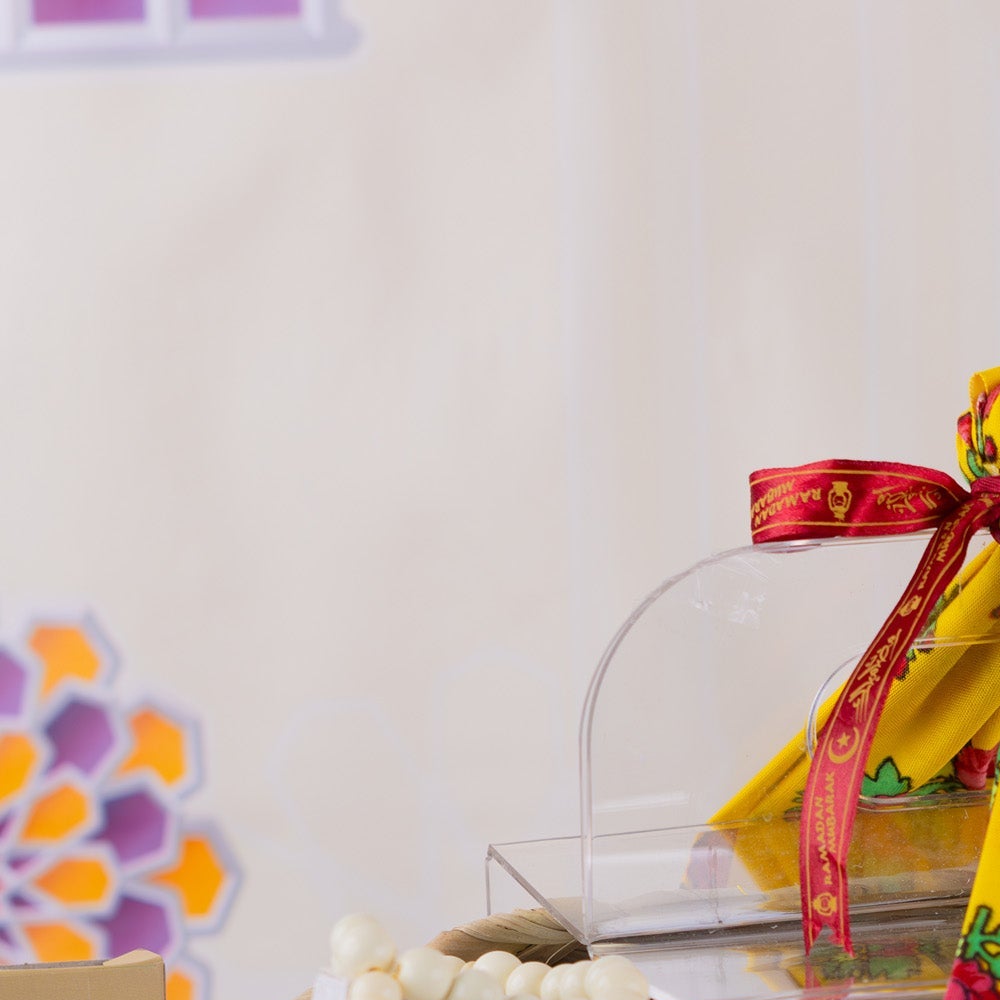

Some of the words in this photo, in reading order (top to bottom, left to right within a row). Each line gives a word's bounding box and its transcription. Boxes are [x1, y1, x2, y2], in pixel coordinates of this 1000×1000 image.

[751, 478, 796, 517] MUBAR
[754, 488, 822, 528] RAMADAN
[814, 796, 833, 886] RAMADAN
[825, 771, 837, 854] MUBARAK
